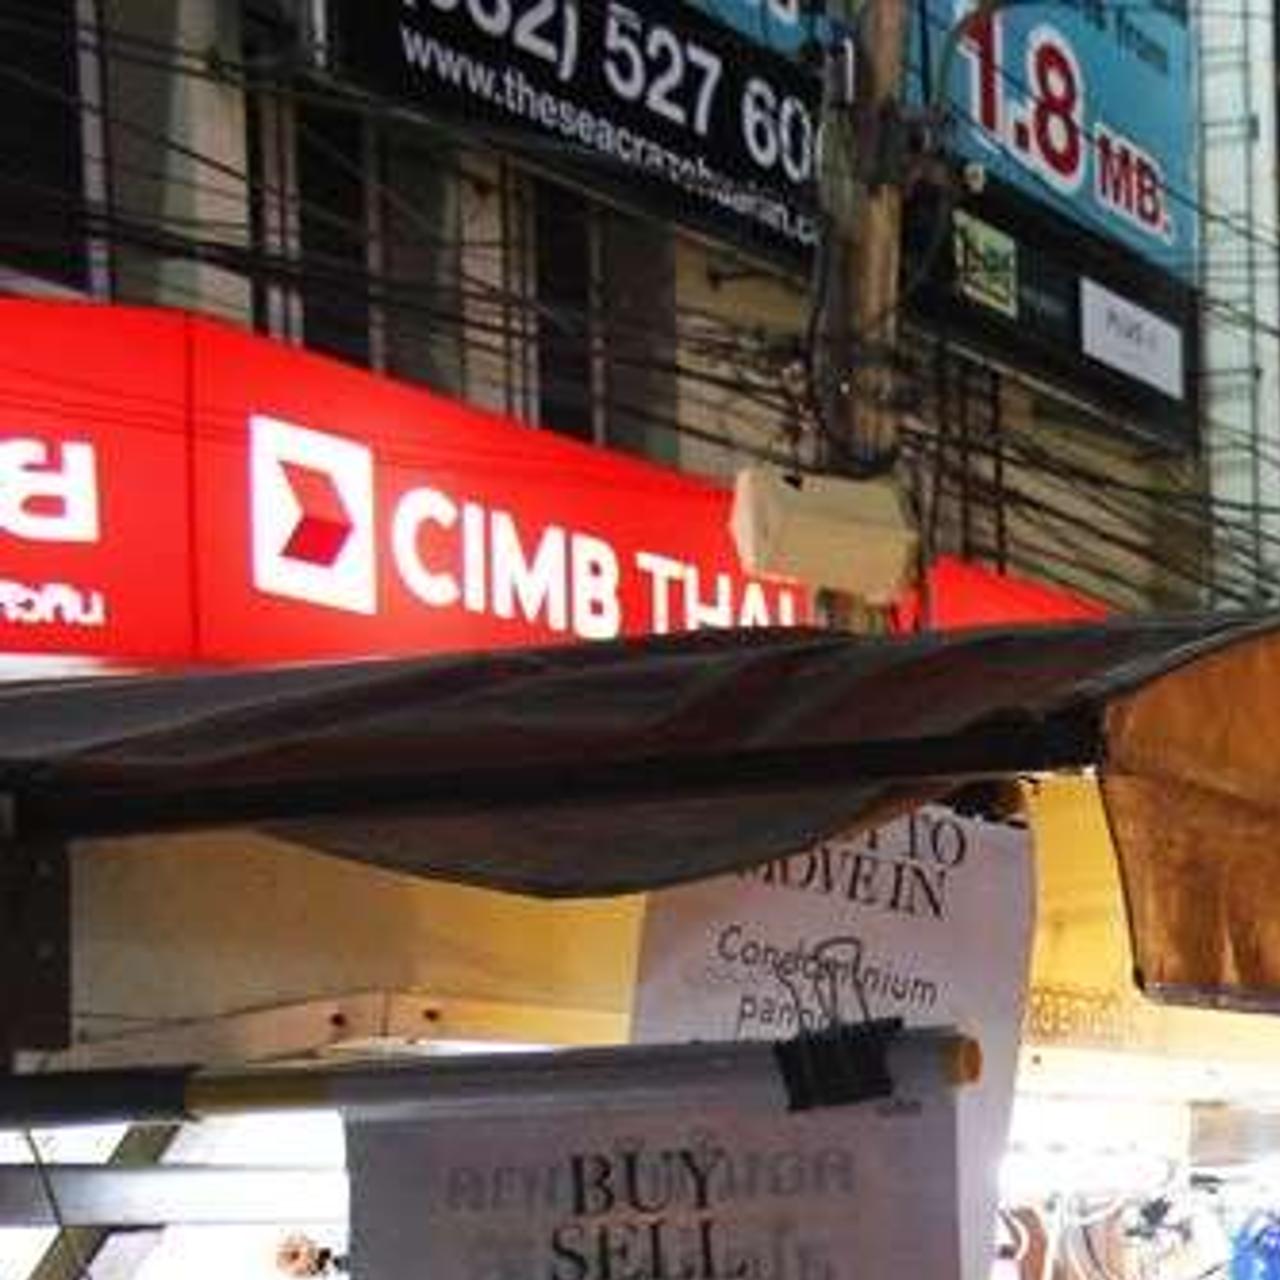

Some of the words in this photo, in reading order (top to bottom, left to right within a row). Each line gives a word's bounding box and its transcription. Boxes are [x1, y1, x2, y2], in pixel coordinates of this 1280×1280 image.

[603, 8, 724, 136] 527
[740, 78, 826, 184] 60
[962, 2, 1084, 184] 1.8
[391, 486, 622, 640] CIMB
[886, 858, 950, 920] IN
[571, 1148, 724, 1218] BUY
